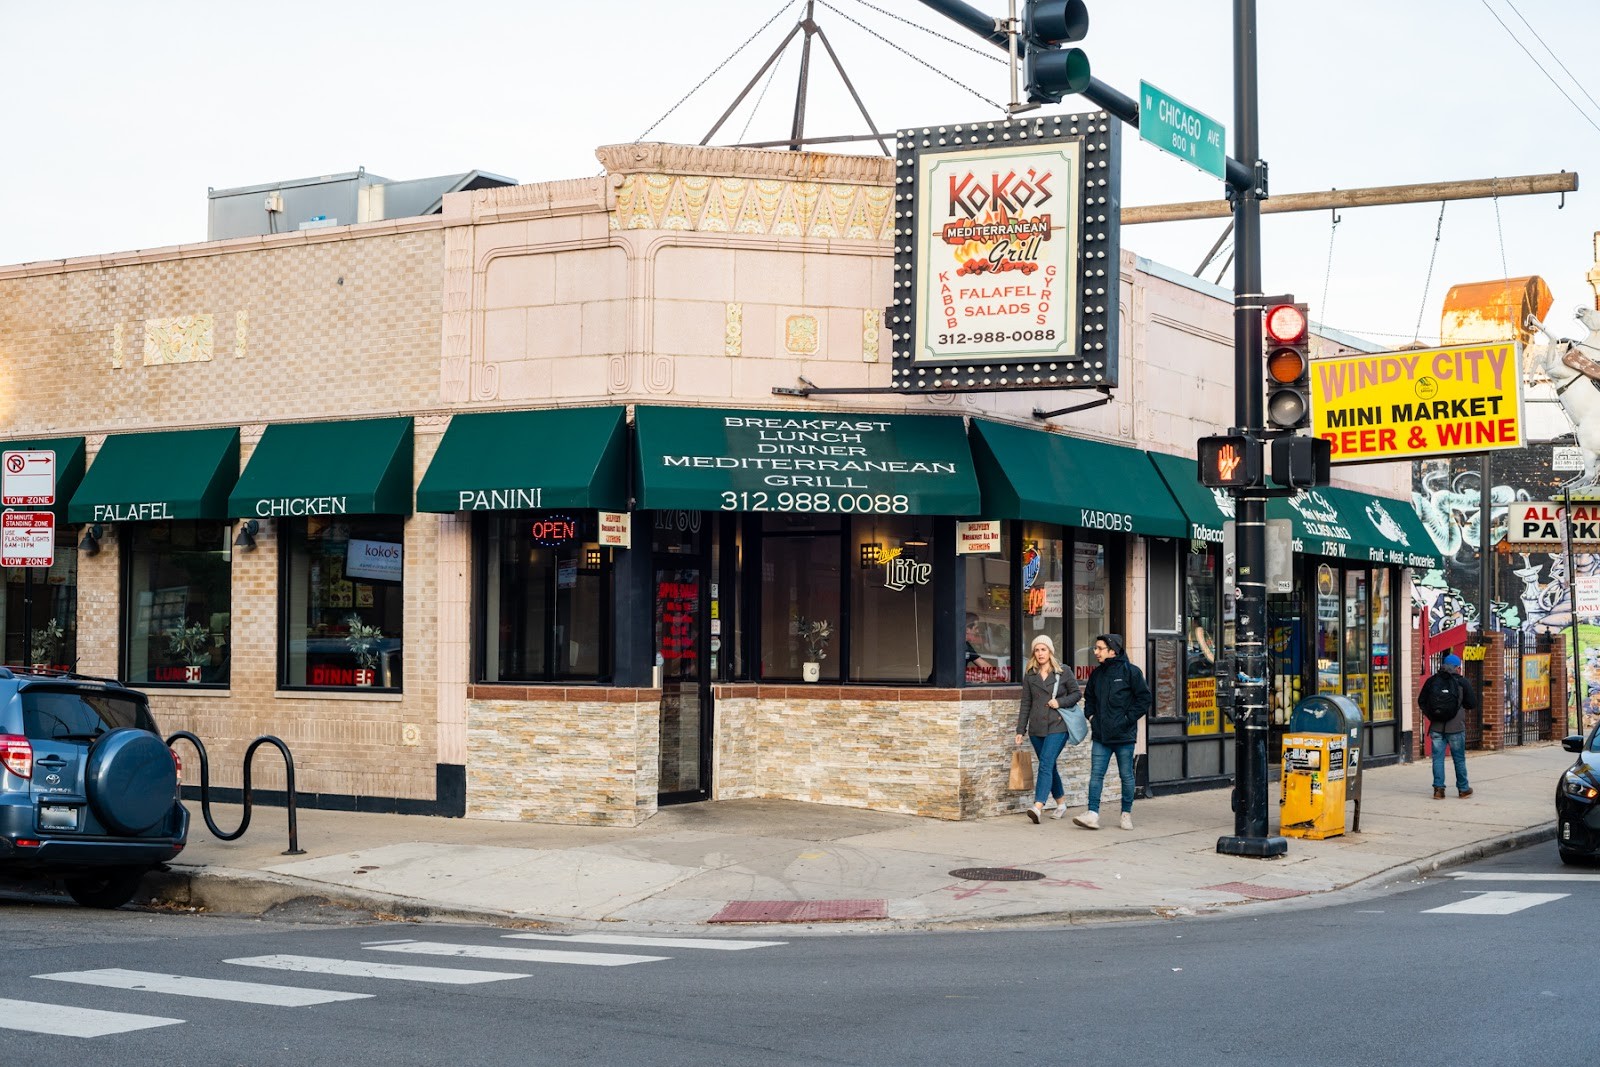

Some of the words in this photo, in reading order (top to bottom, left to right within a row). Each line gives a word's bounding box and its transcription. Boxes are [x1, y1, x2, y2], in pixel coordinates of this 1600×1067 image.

[1146, 94, 1152, 110] W
[1159, 99, 1201, 140] CHICAGO
[1207, 129, 1220, 147] AVE
[1172, 132, 1187, 152] 800
[1190, 142, 1196, 157] N
[947, 222, 1048, 238] MEDITERRANEAN
[988, 236, 1041, 272] Grill
[938, 271, 958, 329] KABOB
[960, 285, 1036, 300] FALAFEL
[1036, 264, 1057, 326] GYROS
[964, 303, 1031, 317] SALADS
[938, 329, 1056, 345] 312-988-0088
[1318, 355, 1420, 404] WINDY
[1432, 348, 1508, 391] CITY
[1326, 406, 1382, 428] MINI
[1391, 395, 1503, 423] MARKET
[724, 416, 892, 432] BREAKFAST
[759, 430, 862, 443] LUNCH
[1321, 428, 1397, 455] BEER
[1407, 426, 1428, 449] &
[1436, 418, 1516, 447] WINE
[757, 443, 867, 456] DINNER
[662, 455, 956, 473] MEDITERRANEAN
[763, 474, 868, 488] GRILL
[28, 496, 49, 504] ZONE
[255, 496, 347, 517] CHICKEN
[458, 487, 542, 511] PANINI
[720, 490, 909, 514] 312.988.0088
[94, 502, 174, 521] FALAFEL
[532, 522, 575, 539] OPEN
[1192, 523, 1224, 542] Tobacco
[1321, 541, 1338, 556] 1756
[1369, 547, 1384, 562] Fruit
[1390, 550, 1404, 564] Meat
[1408, 554, 1436, 568] Groceries
[884, 558, 932, 592] Lite
[155, 666, 201, 681] LUNCH
[313, 668, 375, 685] DINNER
[966, 666, 1012, 682] BREAKFAST
[1373, 675, 1390, 692] EER
[1192, 690, 1214, 699] TOBACCO
[1188, 700, 1213, 709] PRODUCTS
